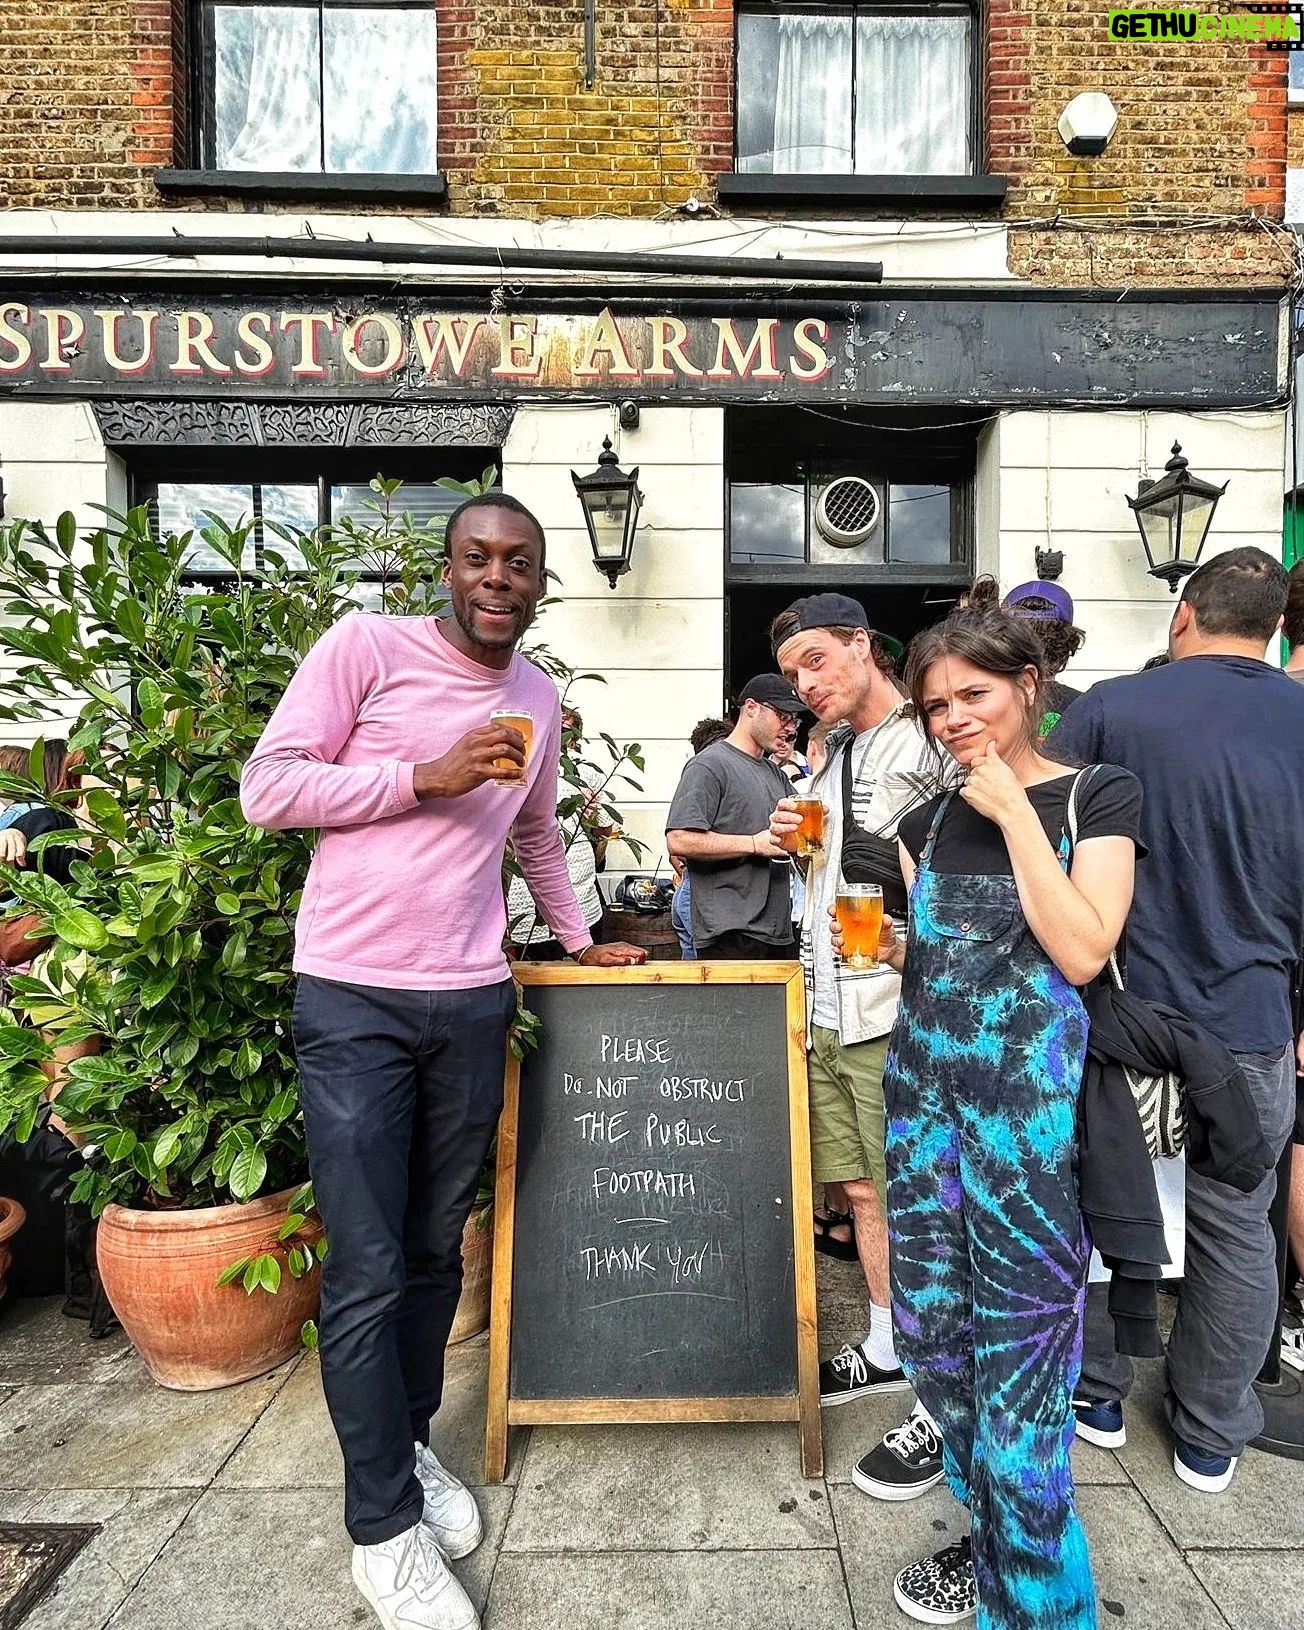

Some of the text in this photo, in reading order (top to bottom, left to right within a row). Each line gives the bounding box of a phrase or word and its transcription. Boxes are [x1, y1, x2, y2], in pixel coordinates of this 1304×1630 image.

[0, 302, 832, 382] SPURSTOWE ARMS
[600, 1034, 673, 1064] PLEASE
[596, 1076, 639, 1099] NOT
[659, 1076, 748, 1103] OBSTRUCT
[573, 1110, 722, 1147] THE PUBLIC
[592, 1167, 696, 1200] FOOTPATH
[580, 1242, 656, 1281] THANK
